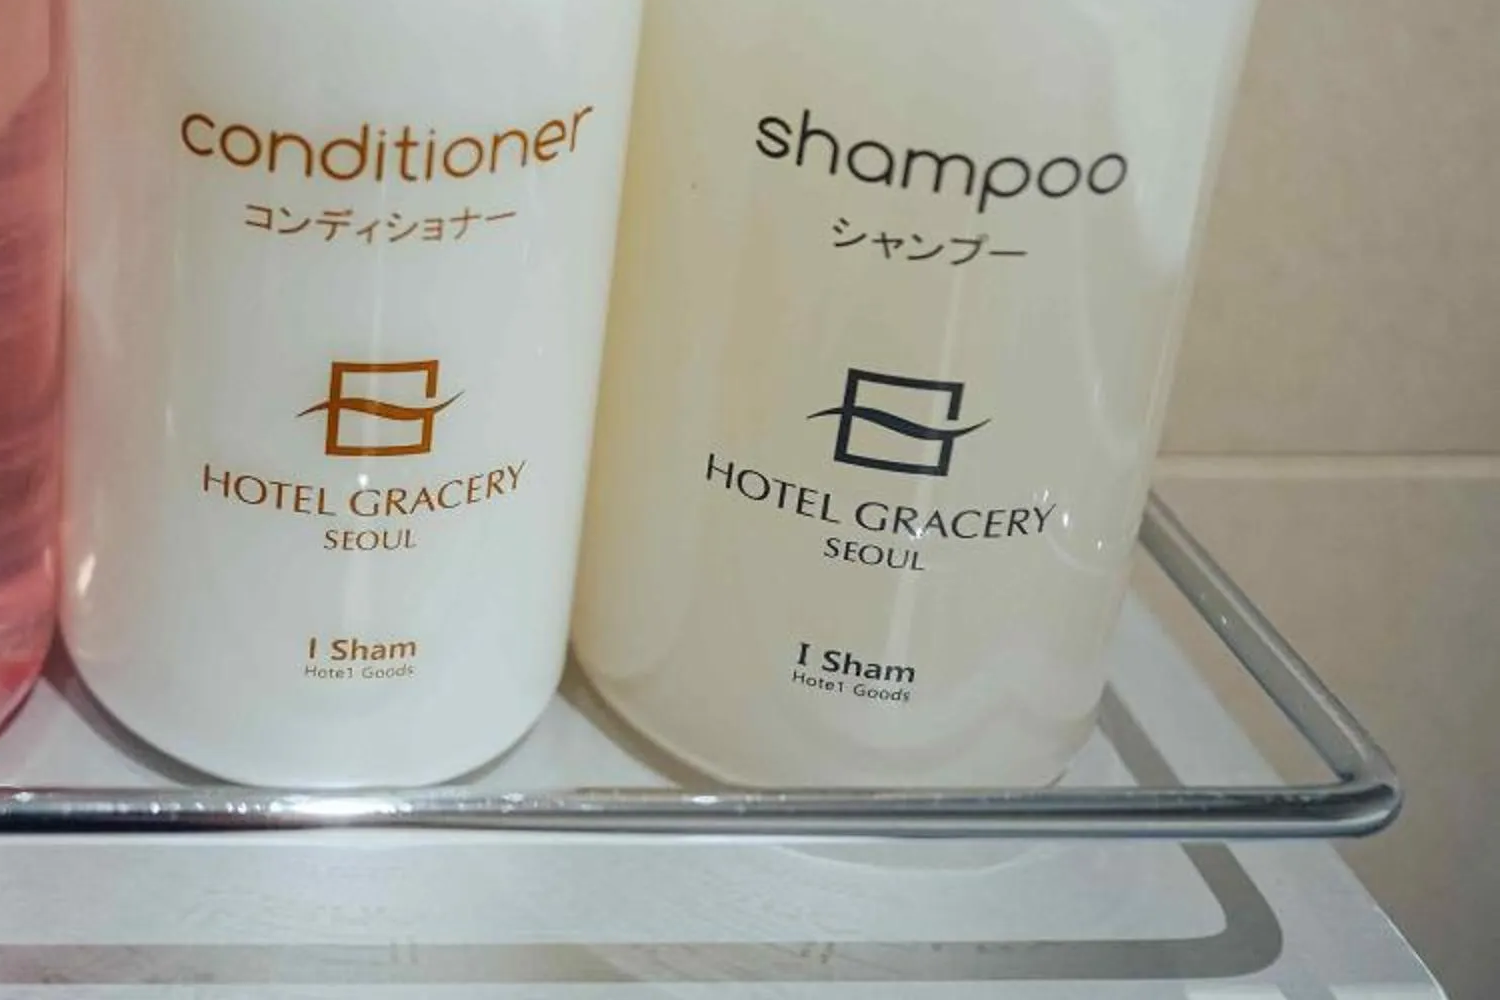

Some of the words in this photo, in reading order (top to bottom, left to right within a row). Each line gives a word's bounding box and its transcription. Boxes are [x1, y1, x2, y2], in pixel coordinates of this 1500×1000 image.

[180, 104, 595, 183] conditioner
[755, 108, 1128, 214] shampoo
[244, 203, 518, 244] コンディショナー
[831, 216, 1029, 266] シャンプー
[202, 463, 337, 518] HOTEL
[349, 459, 528, 518] GRACERY
[705, 452, 841, 525] HOTEL
[854, 501, 1057, 540] GRACERY
[323, 527, 418, 551] SEOUL
[822, 536, 927, 572] SEOUL
[308, 637, 317, 659] I
[330, 638, 417, 661] Sham
[796, 641, 811, 667] I
[820, 649, 916, 684] Sham
[361, 663, 416, 679] Goods
[853, 683, 912, 703] Goods
